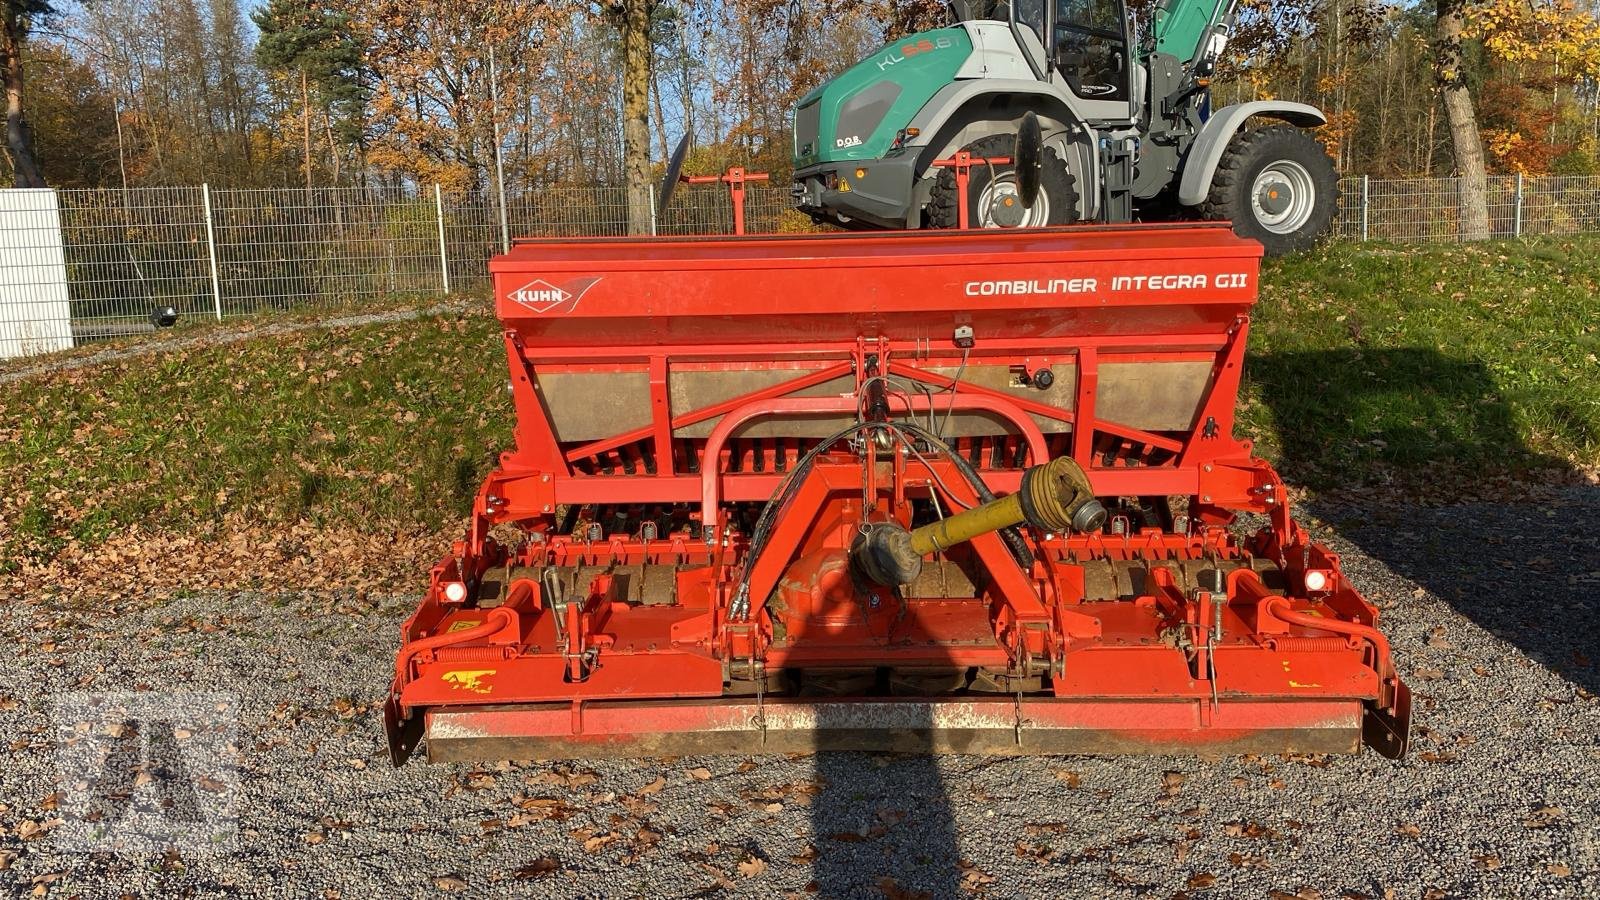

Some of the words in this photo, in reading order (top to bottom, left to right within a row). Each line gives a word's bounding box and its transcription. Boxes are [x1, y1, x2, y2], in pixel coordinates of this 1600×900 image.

[965, 278, 1098, 296] COMBILINER
[1111, 274, 1208, 291] INTEGRA
[1214, 273, 1248, 288] GII
[517, 290, 563, 302] KUHN
